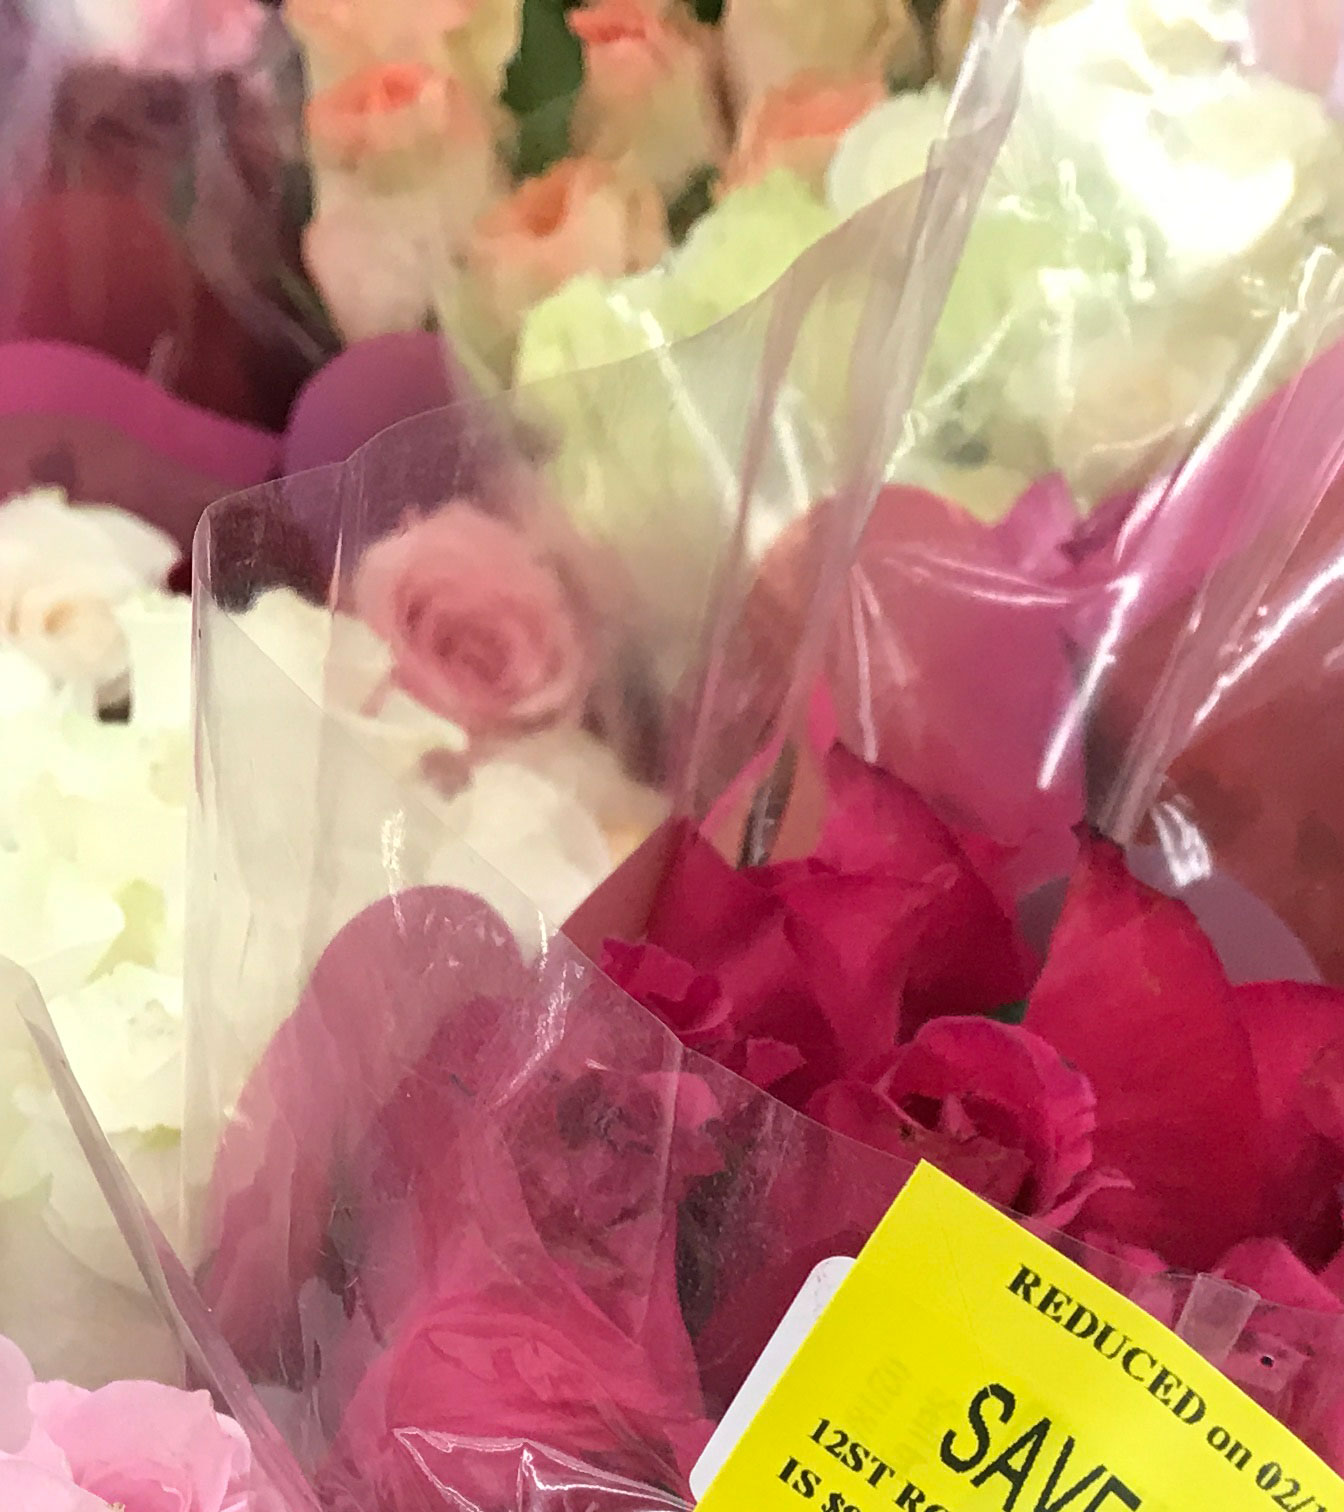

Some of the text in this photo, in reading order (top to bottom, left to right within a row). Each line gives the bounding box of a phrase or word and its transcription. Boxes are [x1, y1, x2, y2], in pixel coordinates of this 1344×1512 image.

[1005, 1264, 1206, 1425] REDUCED
[1206, 1426, 1254, 1471] on
[776, 1456, 823, 1499] IS
[808, 1418, 896, 1489] 12ST
